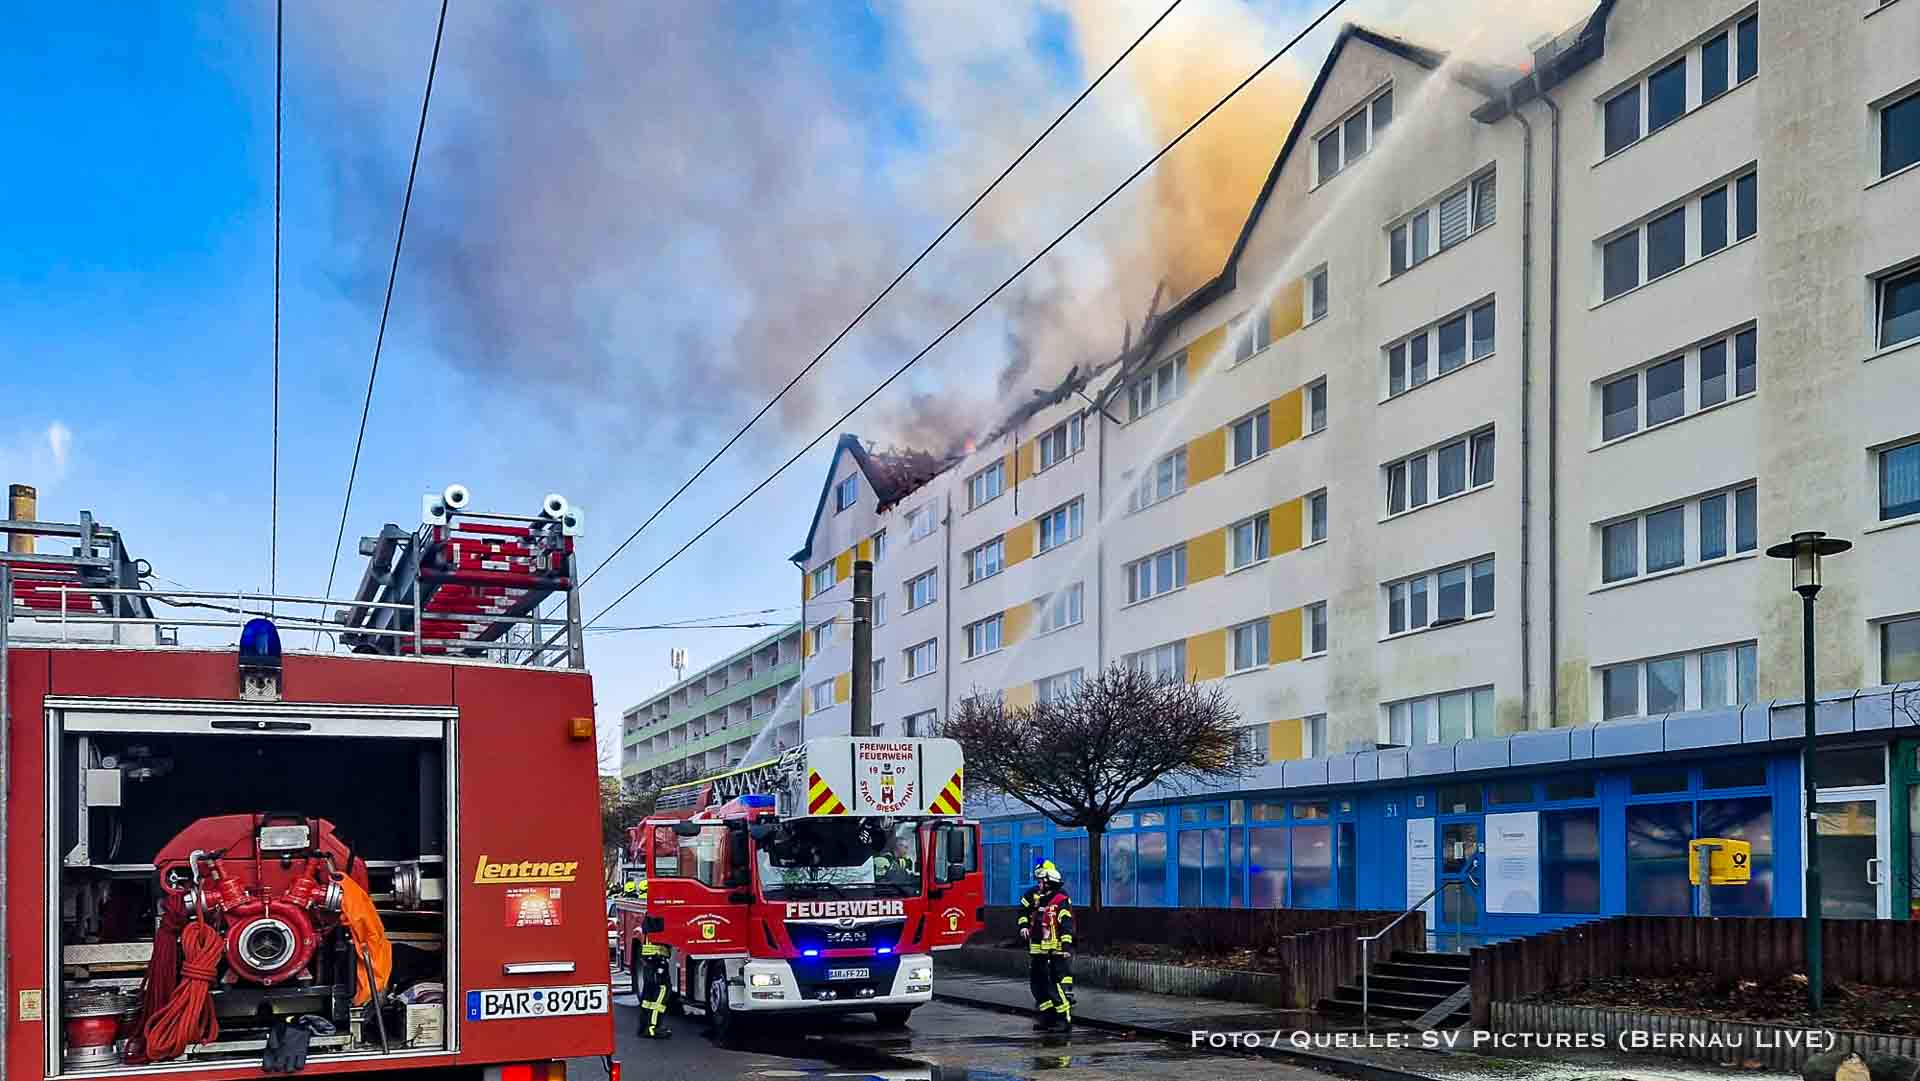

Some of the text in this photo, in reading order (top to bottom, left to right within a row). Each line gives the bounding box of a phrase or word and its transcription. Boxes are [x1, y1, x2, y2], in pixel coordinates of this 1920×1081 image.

[859, 743, 913, 752] FREIWILLIGE
[859, 752, 913, 761] FEUERWEHR
[869, 766, 906, 775] 19 07
[860, 780, 876, 806] STADT
[786, 900, 904, 917] FEUERWEHR
[485, 992, 530, 1015] BAR
[547, 990, 602, 1012] 8905
